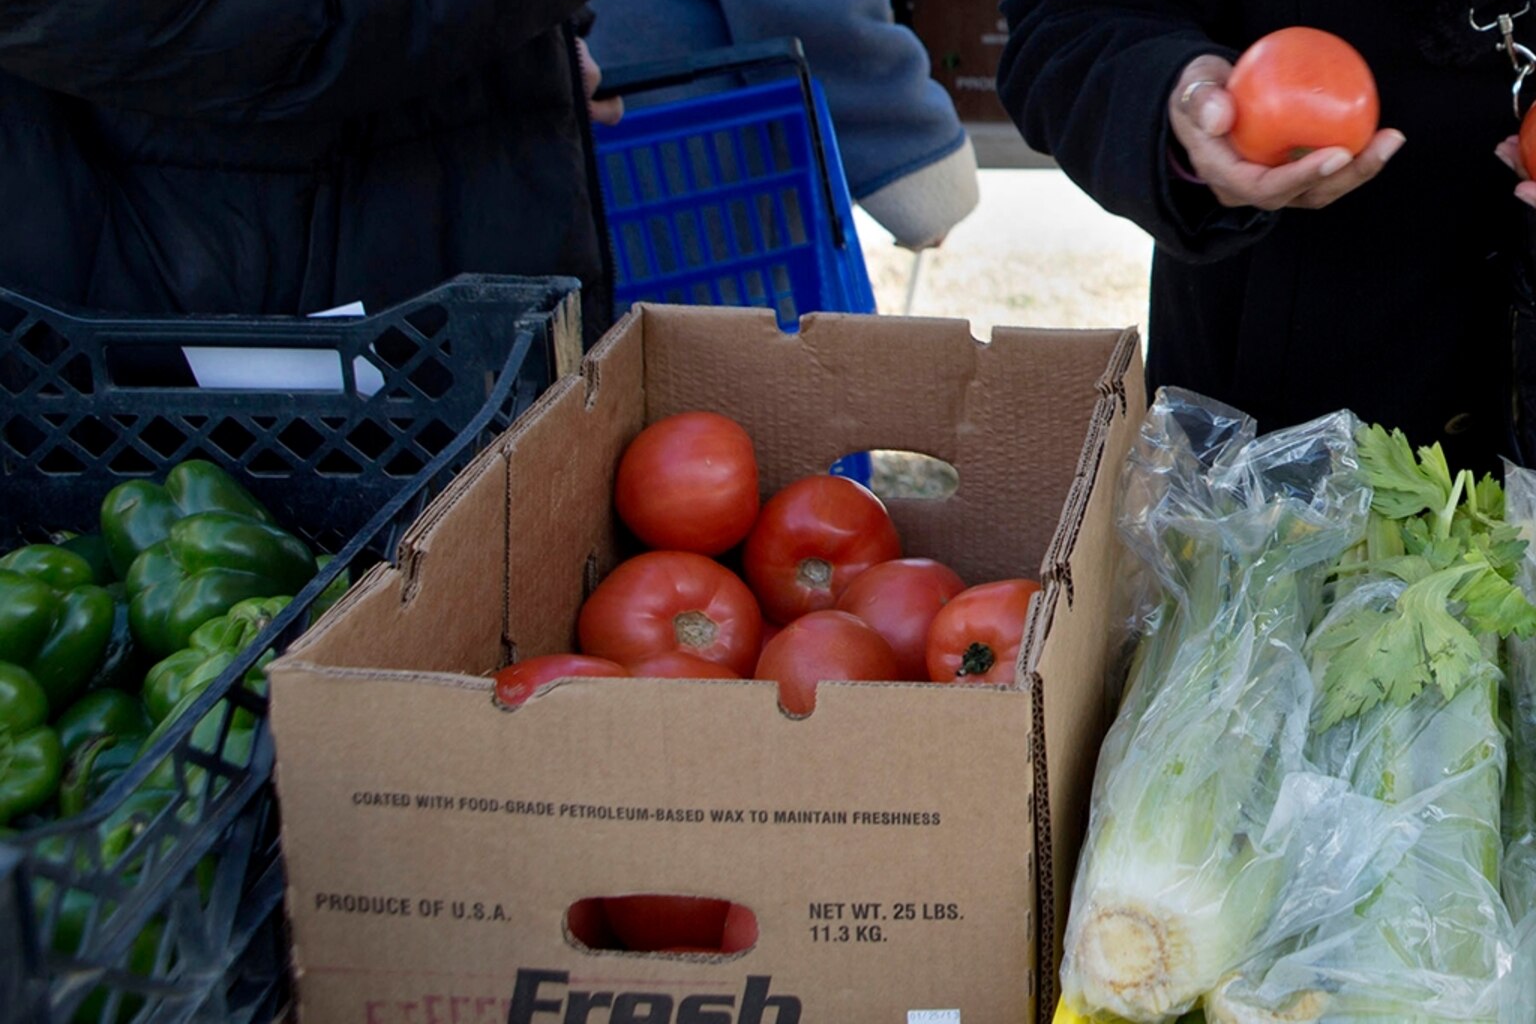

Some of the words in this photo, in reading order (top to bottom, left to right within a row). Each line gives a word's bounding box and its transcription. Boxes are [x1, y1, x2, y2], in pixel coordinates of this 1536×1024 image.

[352, 791, 410, 807] COATED
[415, 794, 454, 810] WITH
[459, 797, 555, 816] FOOD-GRADE
[560, 804, 704, 823] PETROLEUM-BASED
[710, 809, 744, 824] WAX
[751, 810, 768, 824] TO
[774, 810, 847, 825] MAINTAIN
[852, 811, 941, 826] FRESHNESS
[315, 892, 410, 916] PRODUCE
[419, 899, 444, 917] OF
[452, 902, 512, 922] U.S.A.
[809, 903, 845, 920] NET
[852, 903, 887, 920] WT.
[893, 903, 916, 920] 25
[923, 903, 965, 920] LBS.
[810, 925, 850, 942] 11.3
[856, 925, 888, 942] KG.
[508, 967, 802, 1024] Fresh
